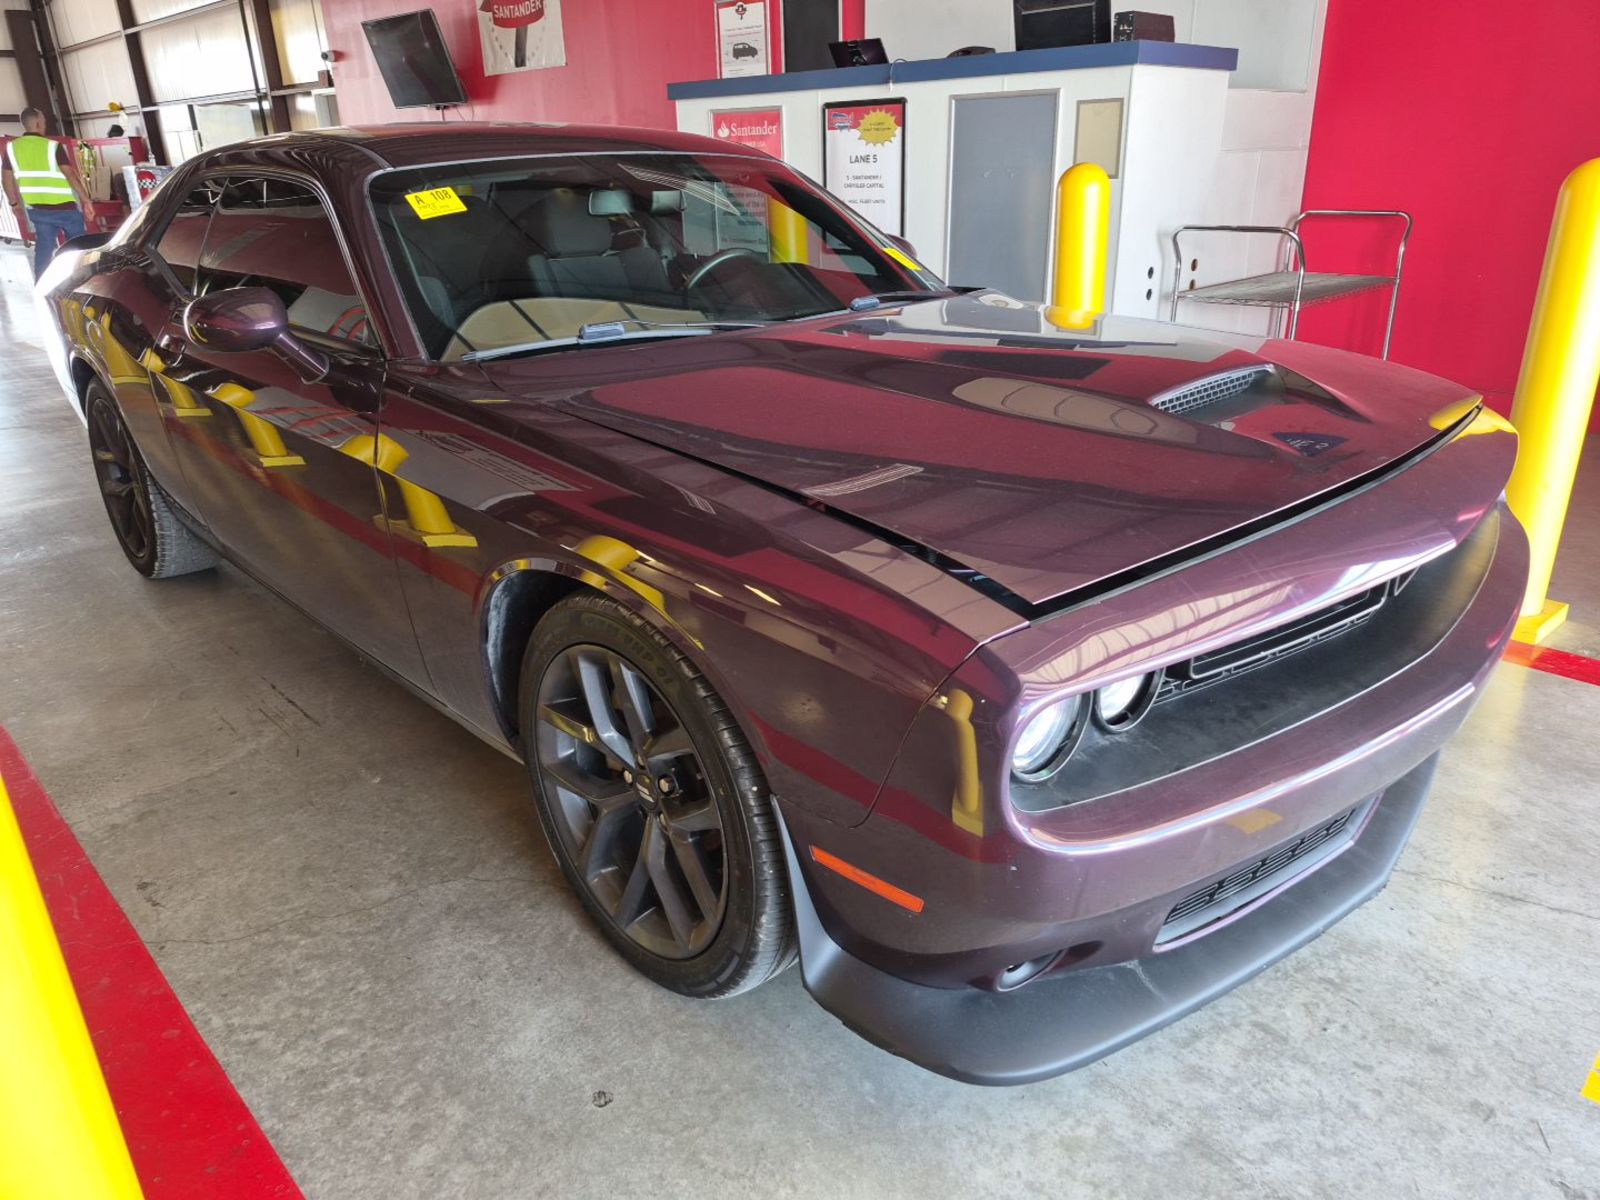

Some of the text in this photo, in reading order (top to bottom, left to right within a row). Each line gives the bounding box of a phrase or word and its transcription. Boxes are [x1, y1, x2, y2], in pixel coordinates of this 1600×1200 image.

[493, 0, 542, 18] SANTANDER
[730, 120, 777, 137] Santander
[849, 154, 878, 164] LANE 5
[414, 189, 452, 205] A 108
